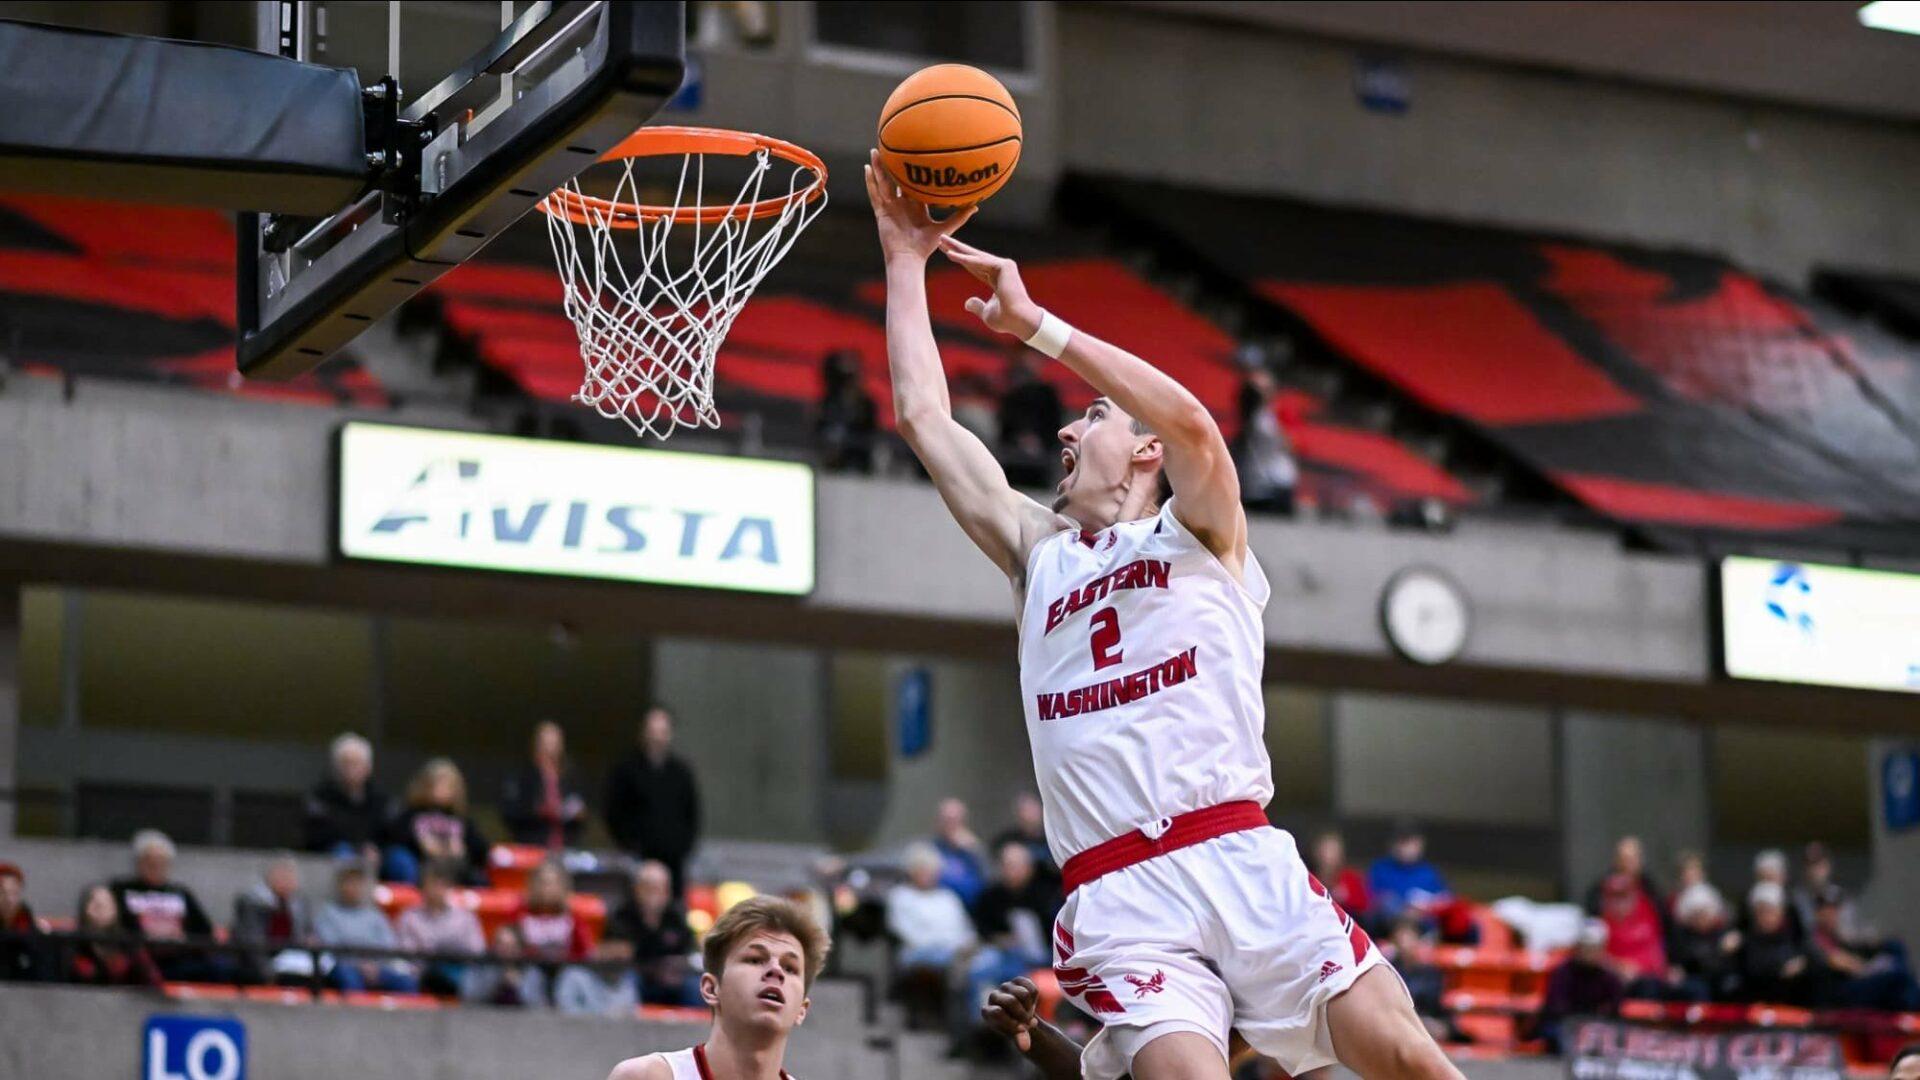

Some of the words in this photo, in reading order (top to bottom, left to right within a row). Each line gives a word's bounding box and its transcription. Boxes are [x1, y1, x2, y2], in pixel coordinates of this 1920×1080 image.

[904, 161, 999, 187] Wilson
[1044, 559, 1171, 636] EASTERN
[1089, 606, 1124, 671] 2
[1037, 646, 1198, 721] WASHINGTON
